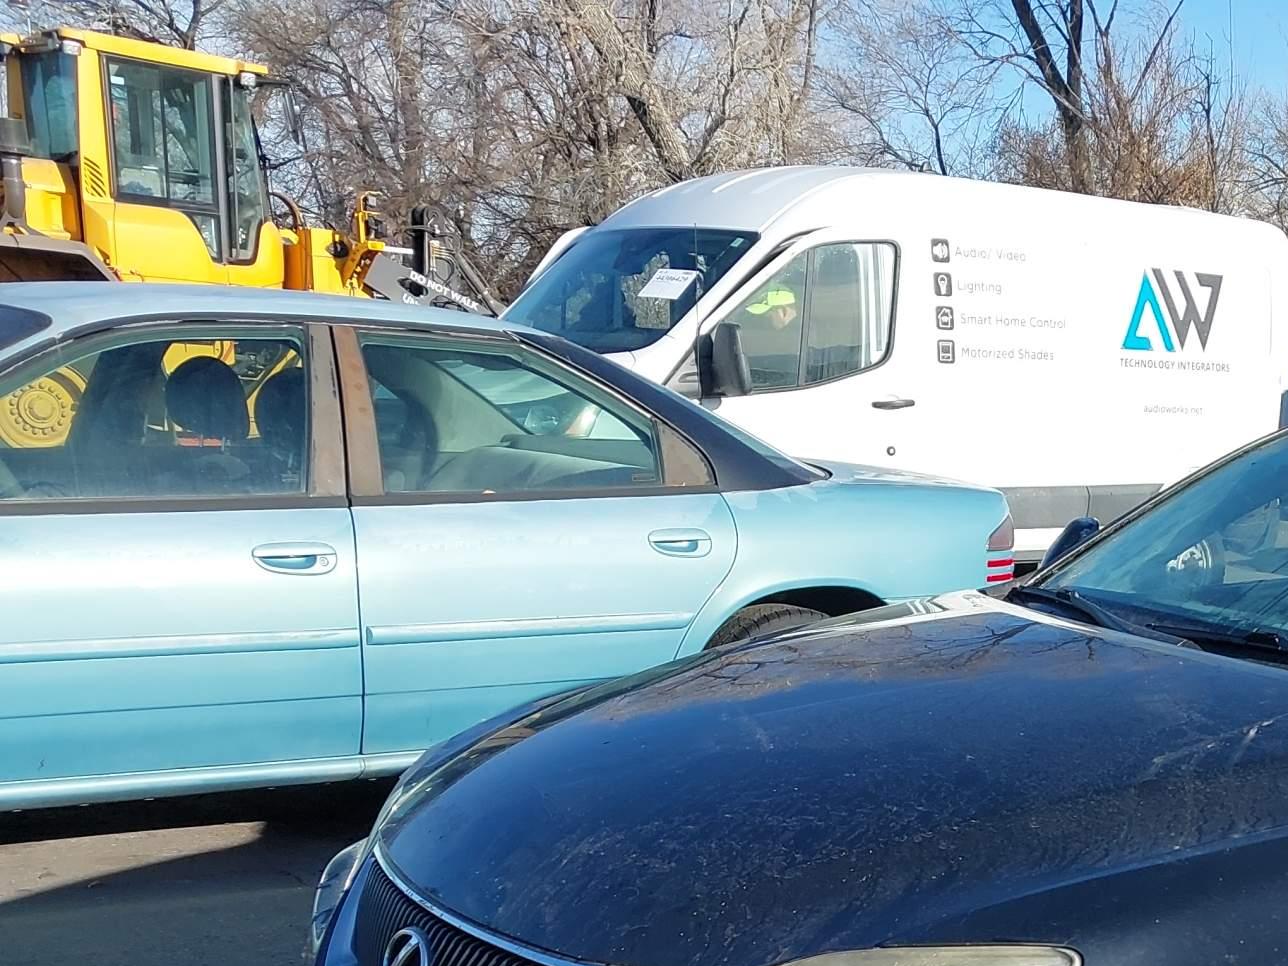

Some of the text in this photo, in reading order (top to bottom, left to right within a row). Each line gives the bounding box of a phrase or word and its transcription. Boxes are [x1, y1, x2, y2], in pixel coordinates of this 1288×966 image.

[996, 247, 1026, 261] Video
[409, 271, 479, 311] DO NOT WALK
[957, 279, 1002, 295] Lighting
[1120, 267, 1223, 352] AW
[960, 313, 1066, 328] Smart Home Control
[961, 347, 1054, 361] Motorized Shades
[1120, 358, 1230, 373] TECHNOLOGY INTEGRATORS
